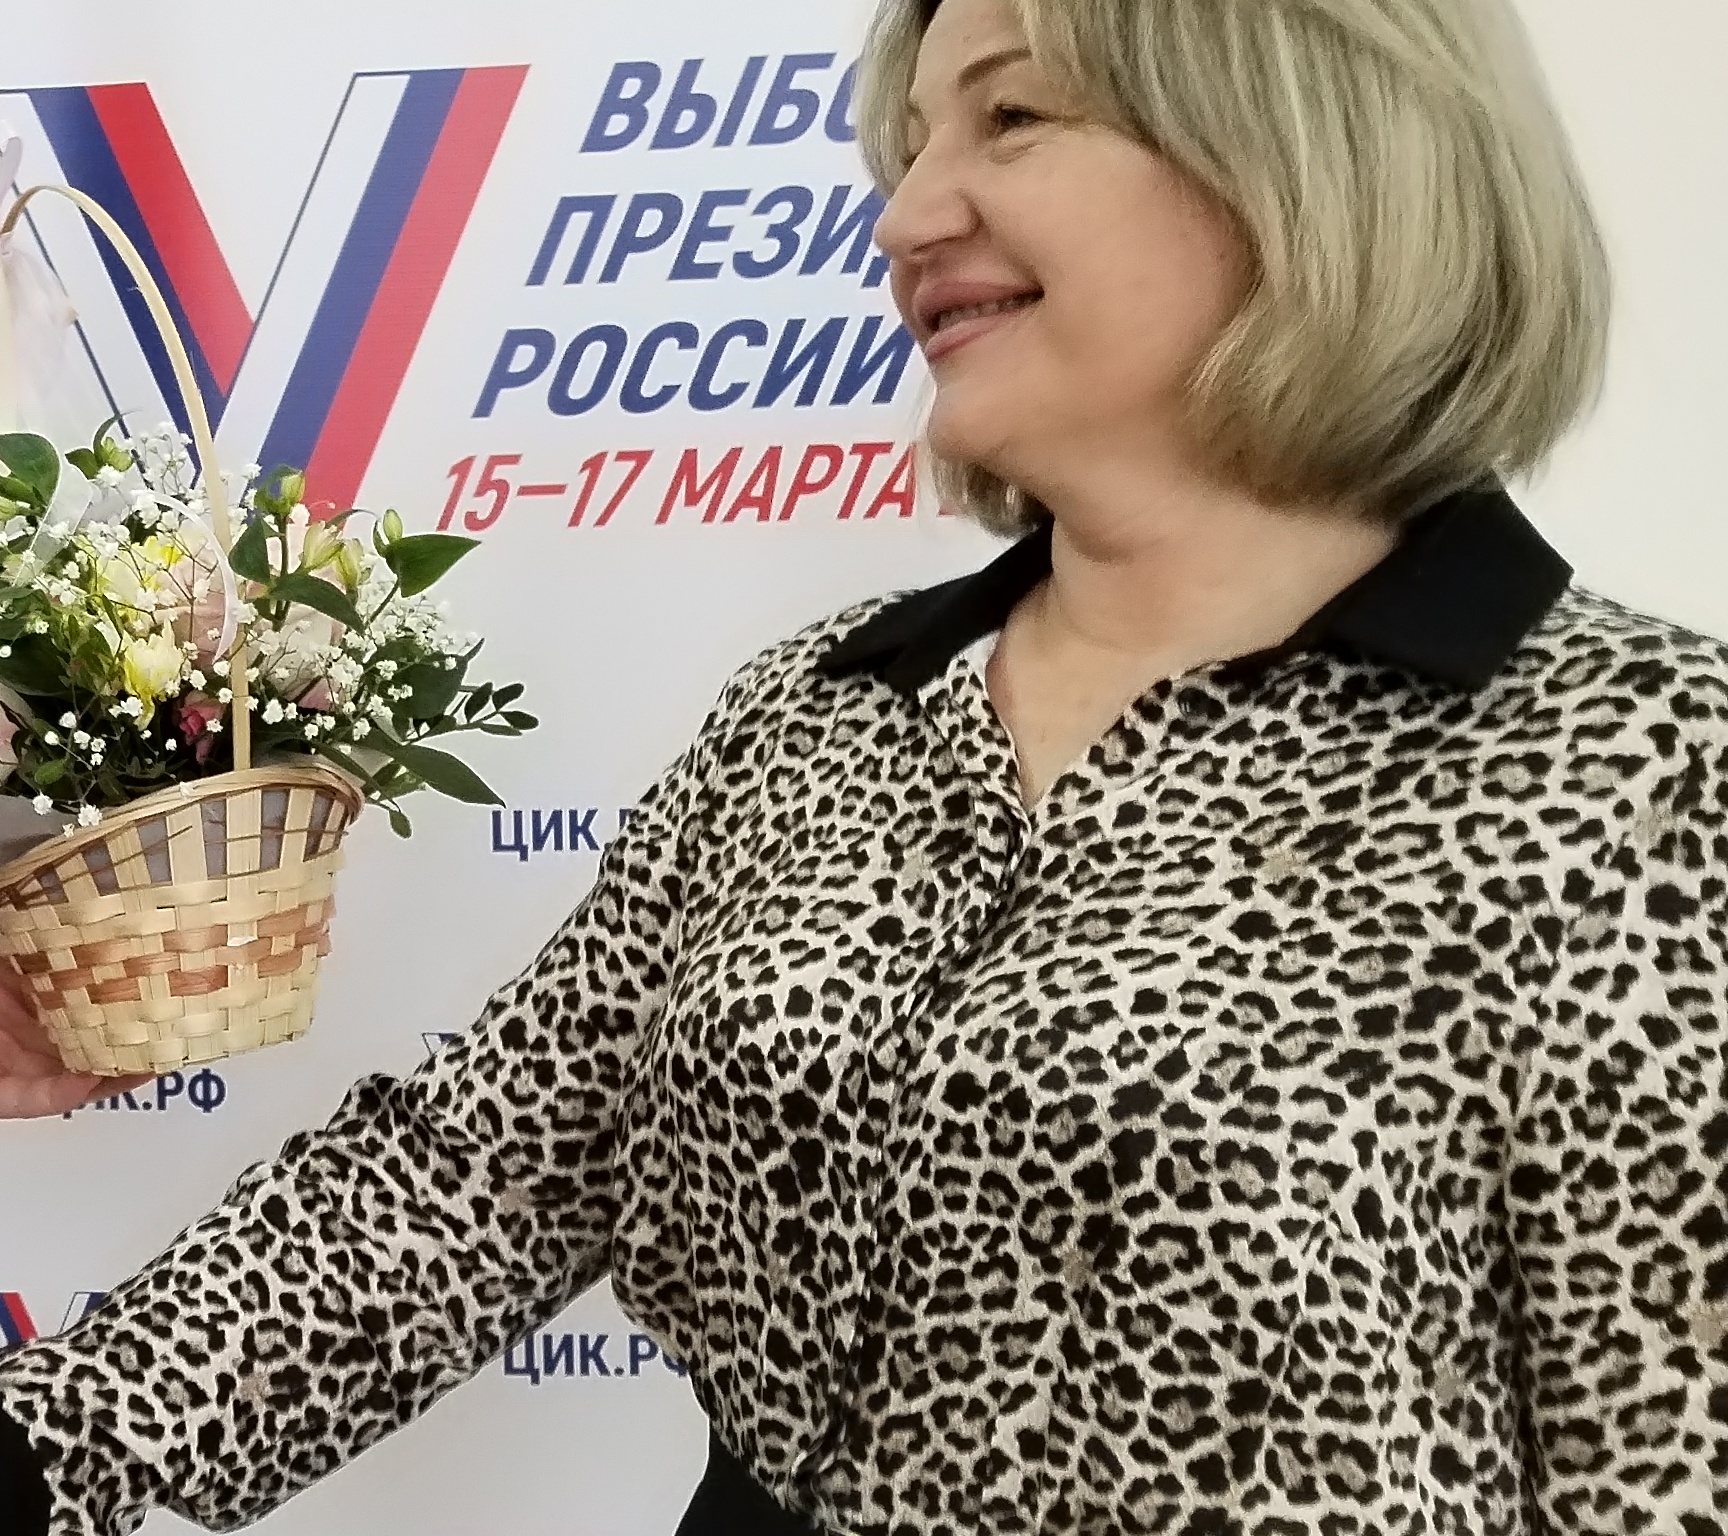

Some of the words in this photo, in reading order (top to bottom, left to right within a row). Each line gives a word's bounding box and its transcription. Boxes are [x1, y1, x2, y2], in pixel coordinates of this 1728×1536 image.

[579, 52, 859, 154] ВЫБ
[525, 185, 890, 289] ПРЕЗИ
[471, 316, 915, 419] РОССИИ
[655, 442, 916, 525] МАРТА
